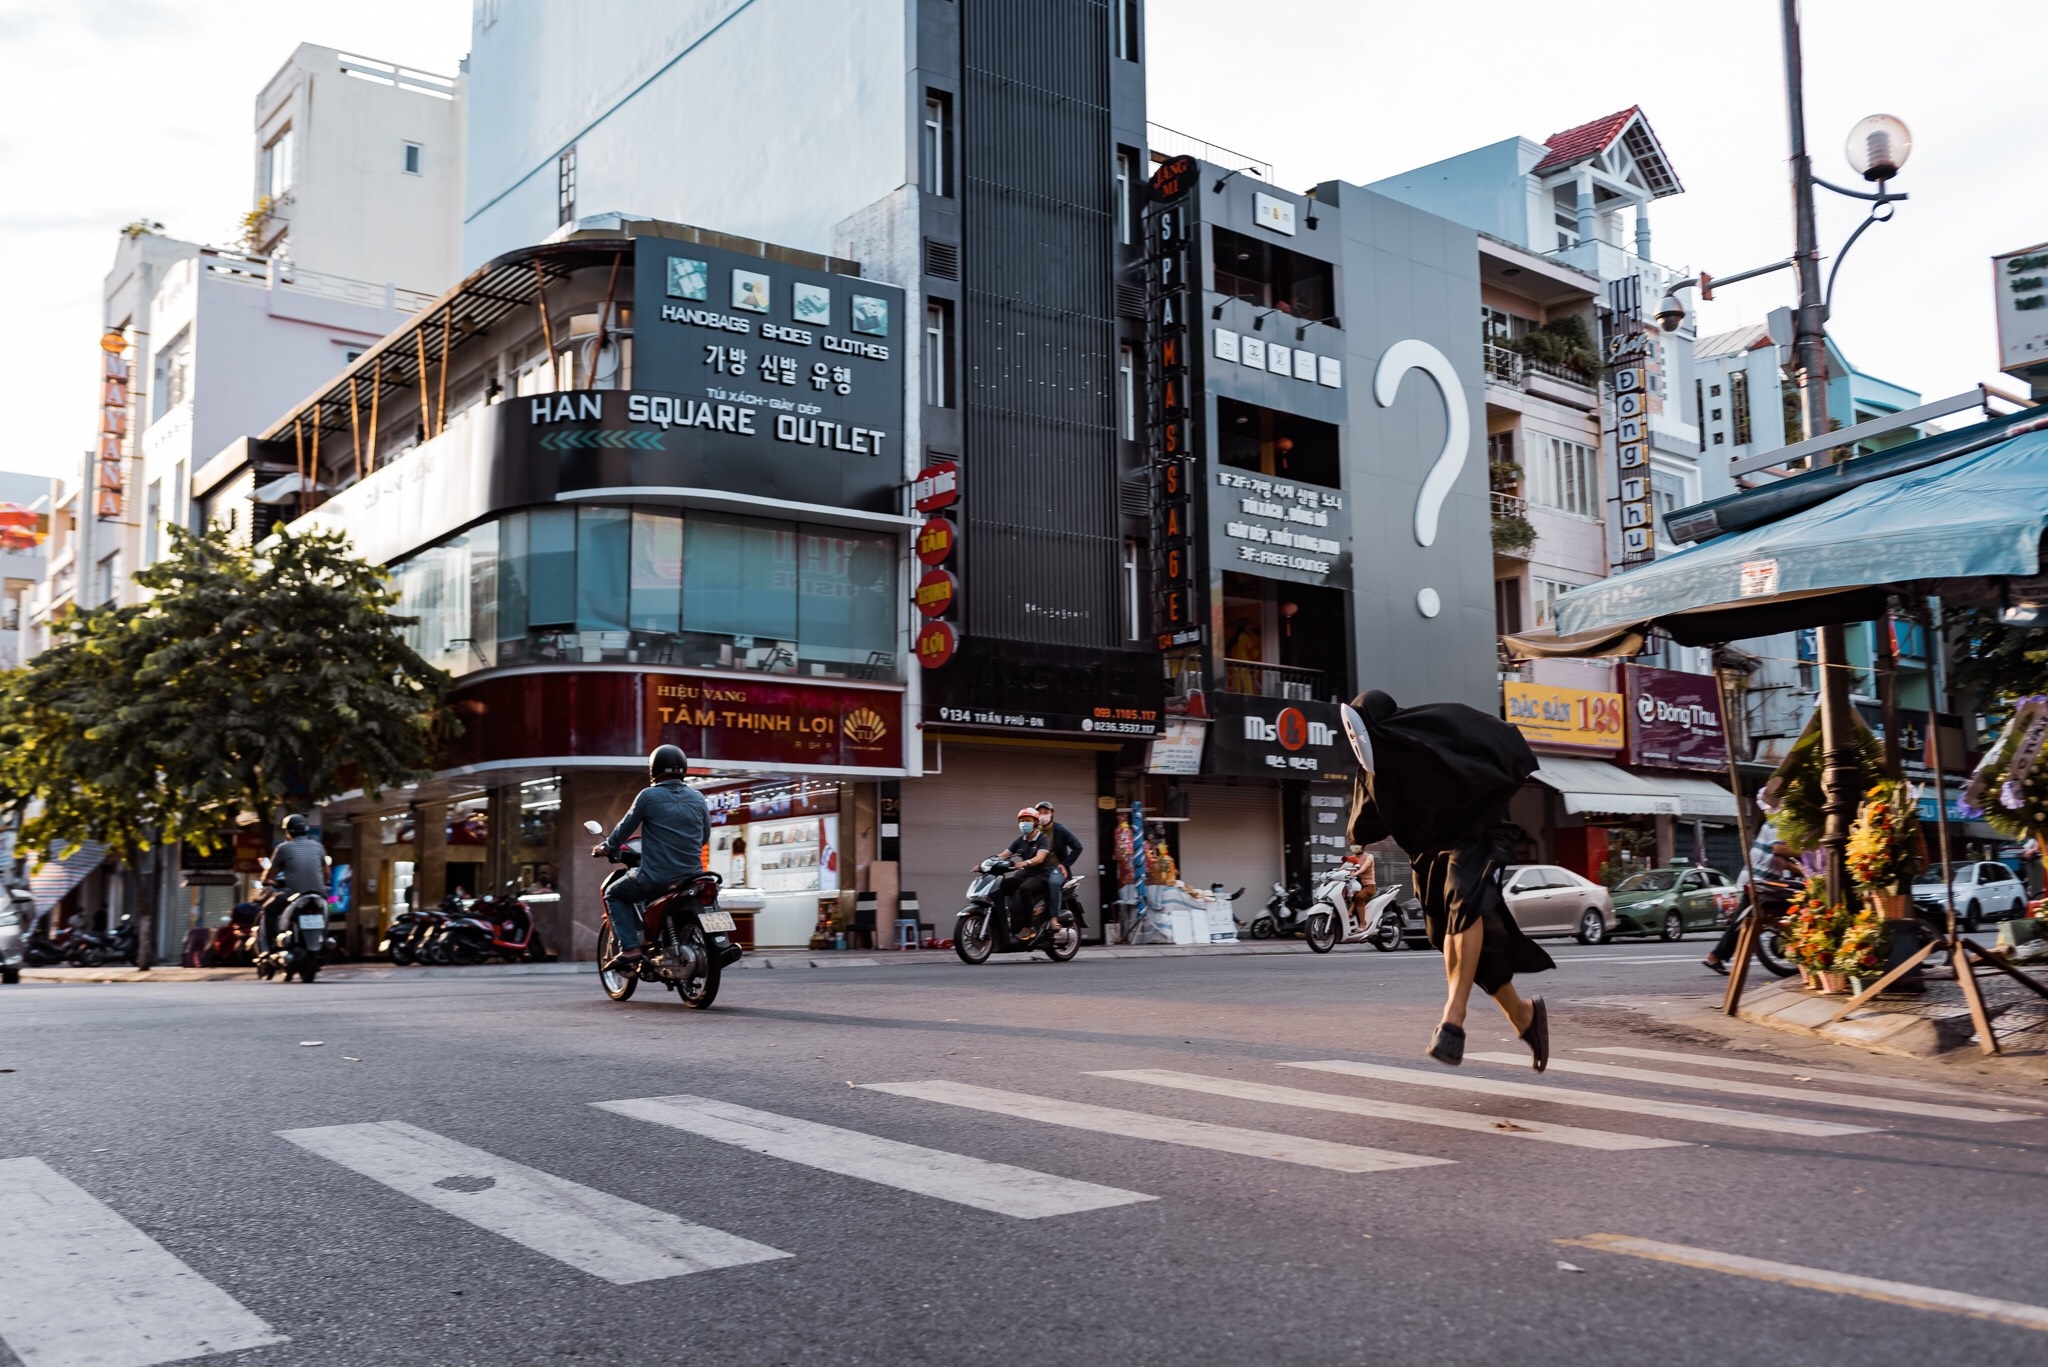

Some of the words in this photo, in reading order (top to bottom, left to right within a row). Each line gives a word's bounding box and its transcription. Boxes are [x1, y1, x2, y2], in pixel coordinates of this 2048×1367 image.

[1161, 213, 1174, 326] SPA
[662, 305, 750, 333] HANDBAGS
[762, 323, 812, 345] SHOES
[824, 335, 889, 360] CLOTHES
[705, 345, 747, 376] 가방
[761, 354, 798, 385] 신발
[811, 362, 852, 395] 유행
[706, 387, 727, 400] TÚI
[797, 403, 822, 415] DÉP
[531, 395, 602, 425] HAN
[628, 394, 756, 436] SQUARE
[777, 414, 886, 456] OUTLET
[1163, 339, 1180, 620] MASSAGE
[918, 528, 947, 554] TÂM
[922, 631, 945, 659] LỢI
[657, 684, 699, 700] HIỆU
[658, 703, 715, 727] TÂM
[721, 711, 791, 734] THỊNH
[799, 716, 834, 738] LỢI
[950, 709, 971, 722] 134
[1577, 696, 1621, 733] 128
